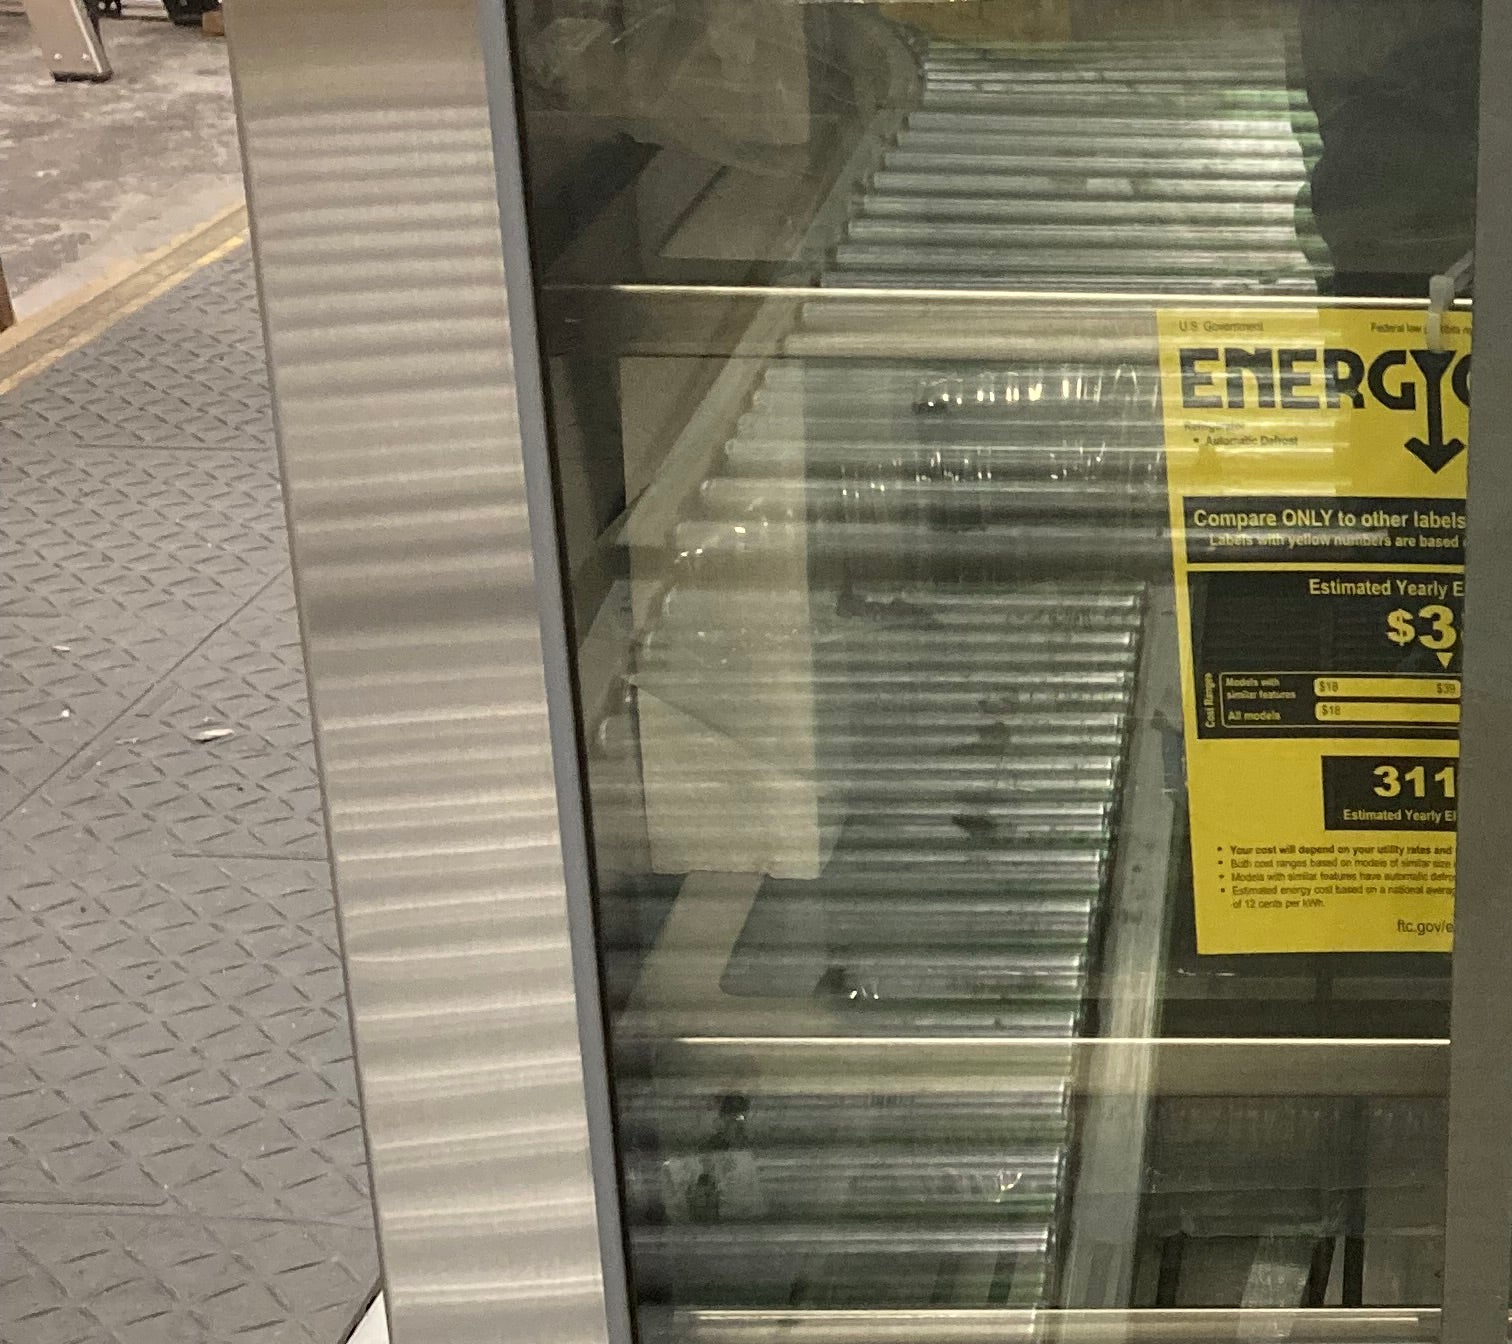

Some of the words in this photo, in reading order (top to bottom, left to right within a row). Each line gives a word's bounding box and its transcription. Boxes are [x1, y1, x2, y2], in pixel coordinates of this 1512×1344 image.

[1193, 509, 1277, 531] Compare
[1282, 508, 1334, 527] ONLY
[1337, 511, 1356, 527] to
[1361, 510, 1409, 529] other
[1413, 510, 1467, 530] labels
[1209, 533, 1252, 546] Labels
[1257, 532, 1284, 545] with
[1288, 533, 1330, 549] yellow
[1333, 533, 1392, 547] numbers
[1395, 537, 1416, 547] are
[1419, 534, 1459, 548] based
[1308, 577, 1392, 596] Estimated
[1395, 579, 1449, 600] Yearly
[1385, 604, 1459, 649] $3
[1373, 765, 1456, 798] 311
[1343, 809, 1401, 821] Estimated
[1405, 809, 1442, 823] Yearly
